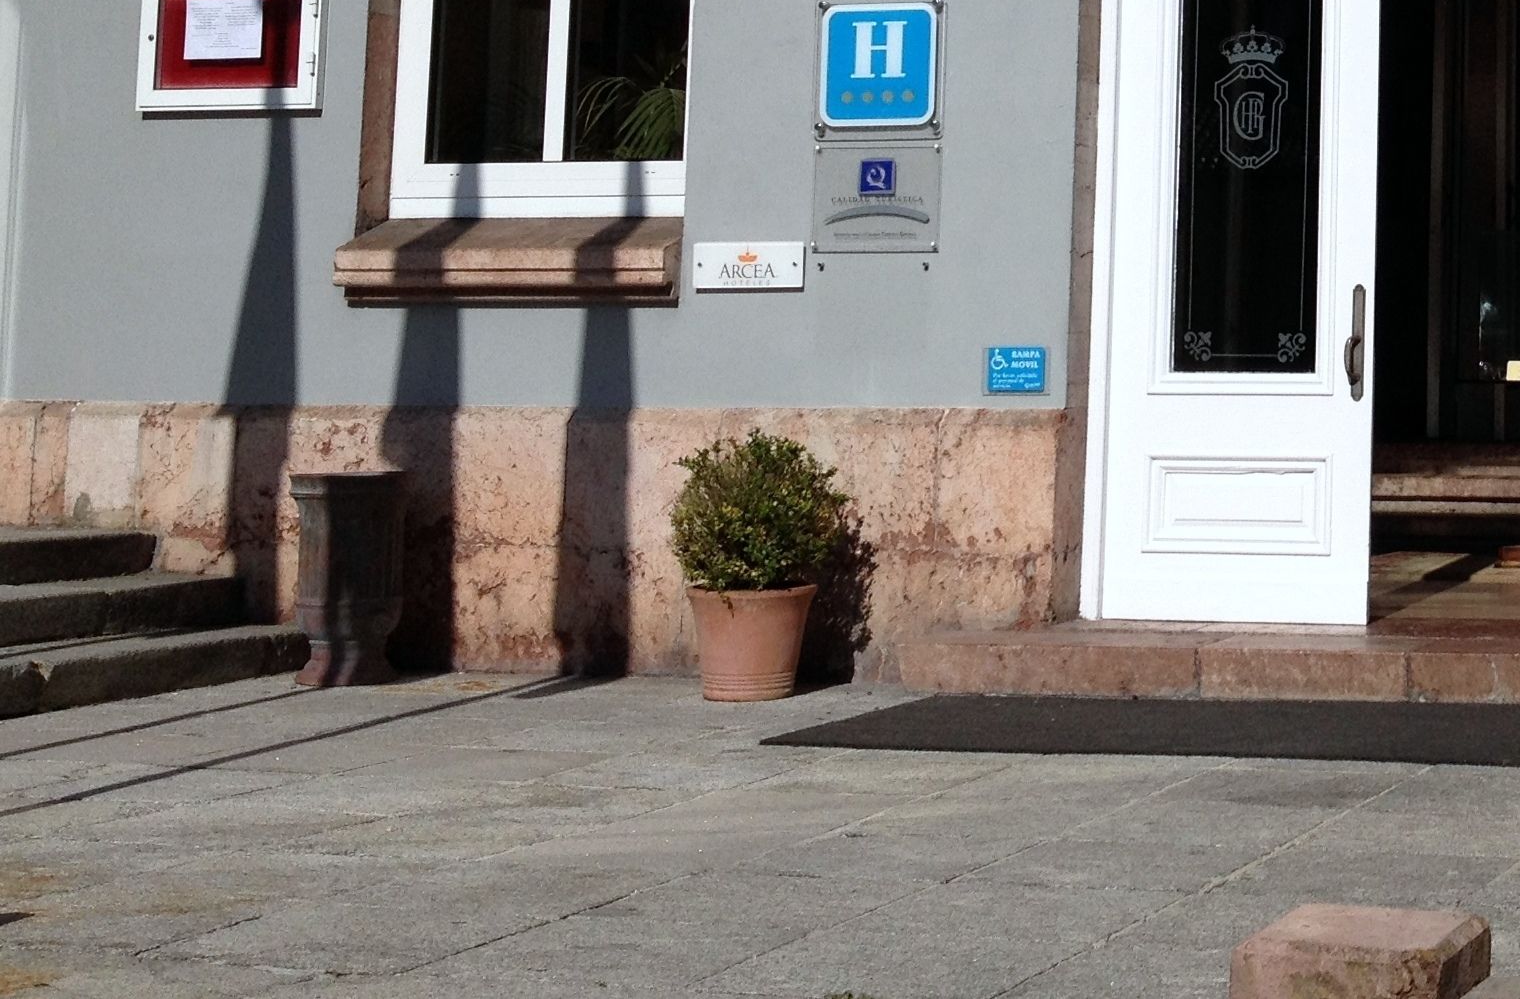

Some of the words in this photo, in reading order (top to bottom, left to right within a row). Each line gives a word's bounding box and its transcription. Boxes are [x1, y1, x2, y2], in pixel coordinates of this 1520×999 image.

[850, 20, 908, 80] H
[718, 262, 777, 279] ARCEA
[1011, 350, 1041, 359] RAMPA
